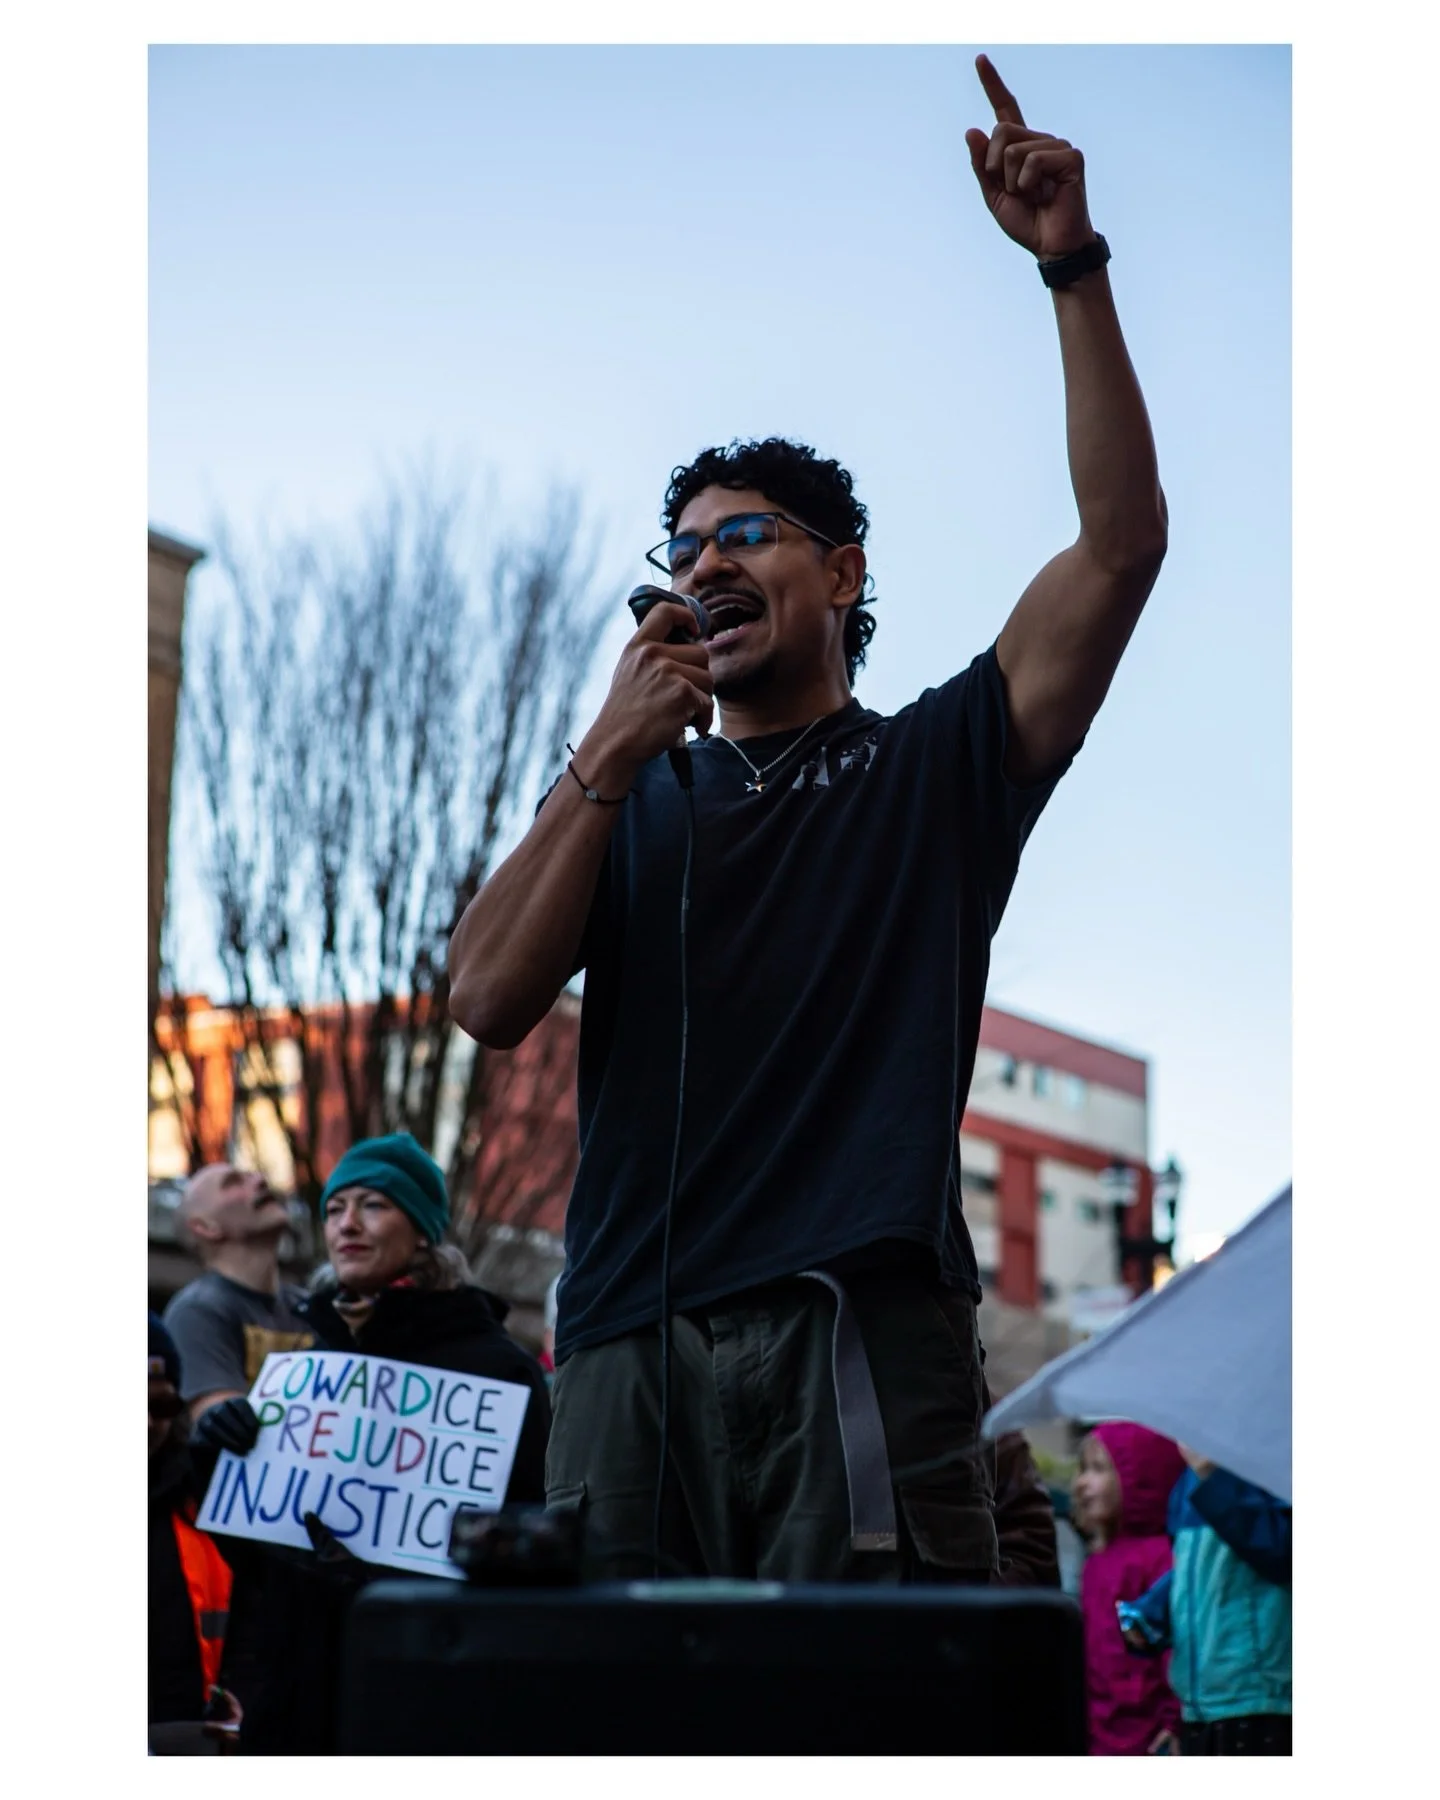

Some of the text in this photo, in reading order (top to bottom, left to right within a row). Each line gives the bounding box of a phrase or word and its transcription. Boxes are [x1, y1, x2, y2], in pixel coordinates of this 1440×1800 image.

[257, 1356, 502, 1434] COWARDICE
[257, 1401, 499, 1493] PREJUDICE
[208, 1459, 481, 1549] INJUSTIC
